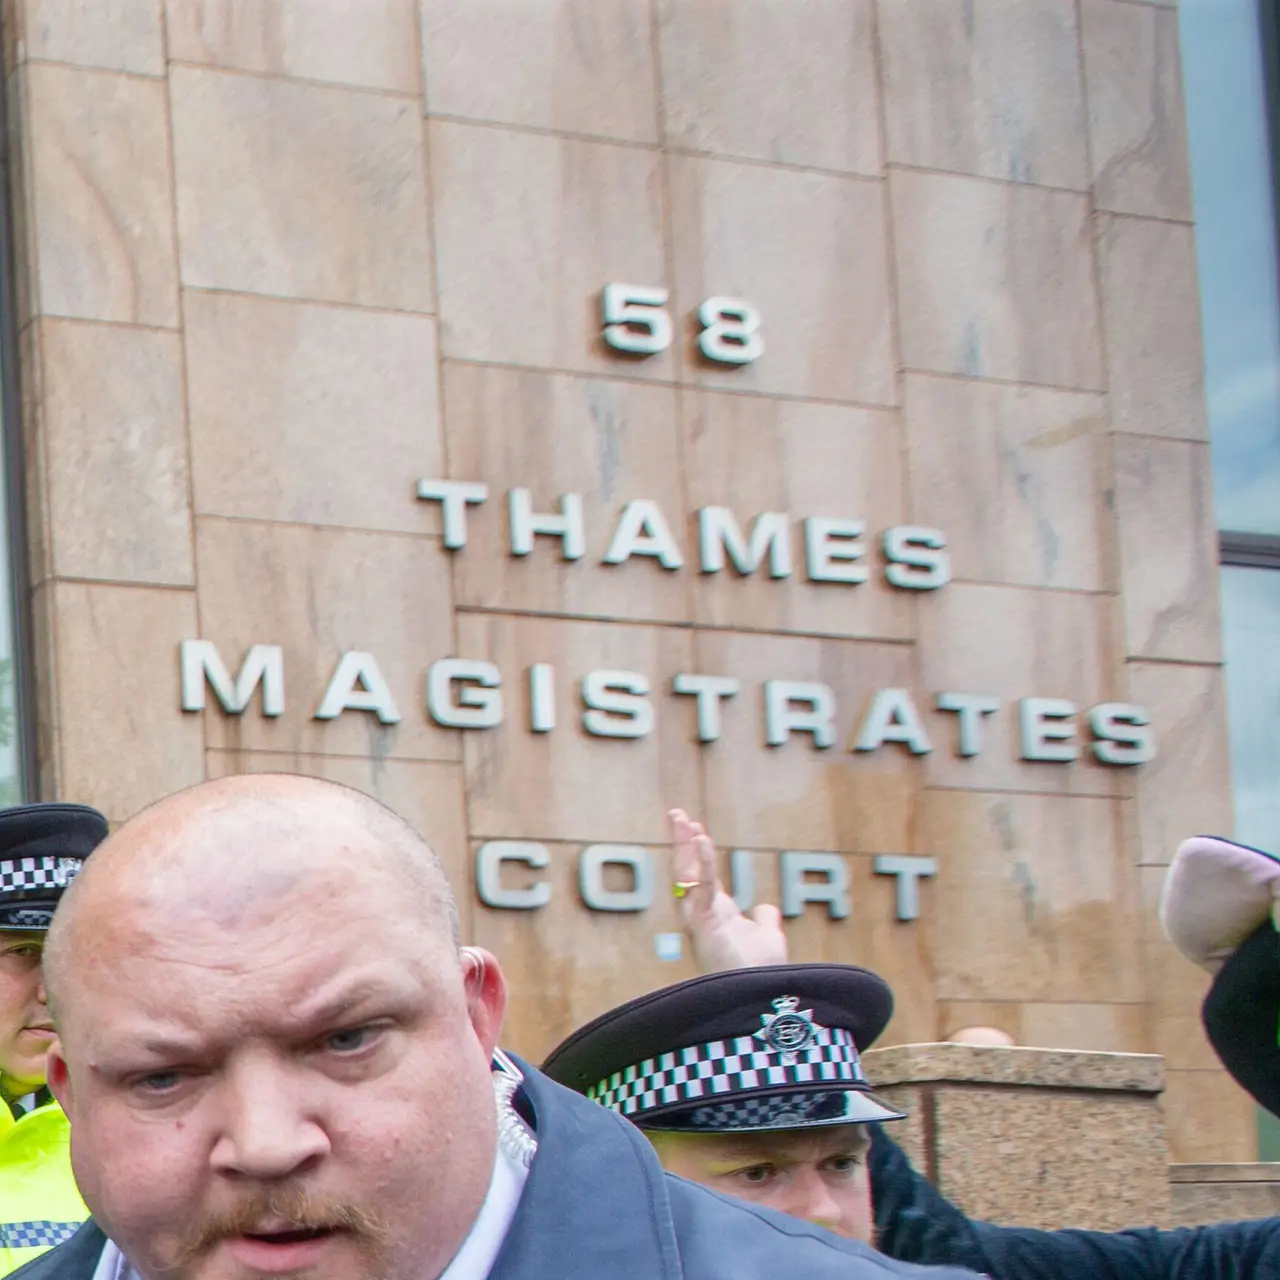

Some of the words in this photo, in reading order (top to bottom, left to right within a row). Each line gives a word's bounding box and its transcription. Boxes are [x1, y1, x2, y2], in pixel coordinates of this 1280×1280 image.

[602, 282, 766, 365] 58
[417, 477, 952, 591] THAMES
[181, 638, 1157, 765] MAGISTRATES
